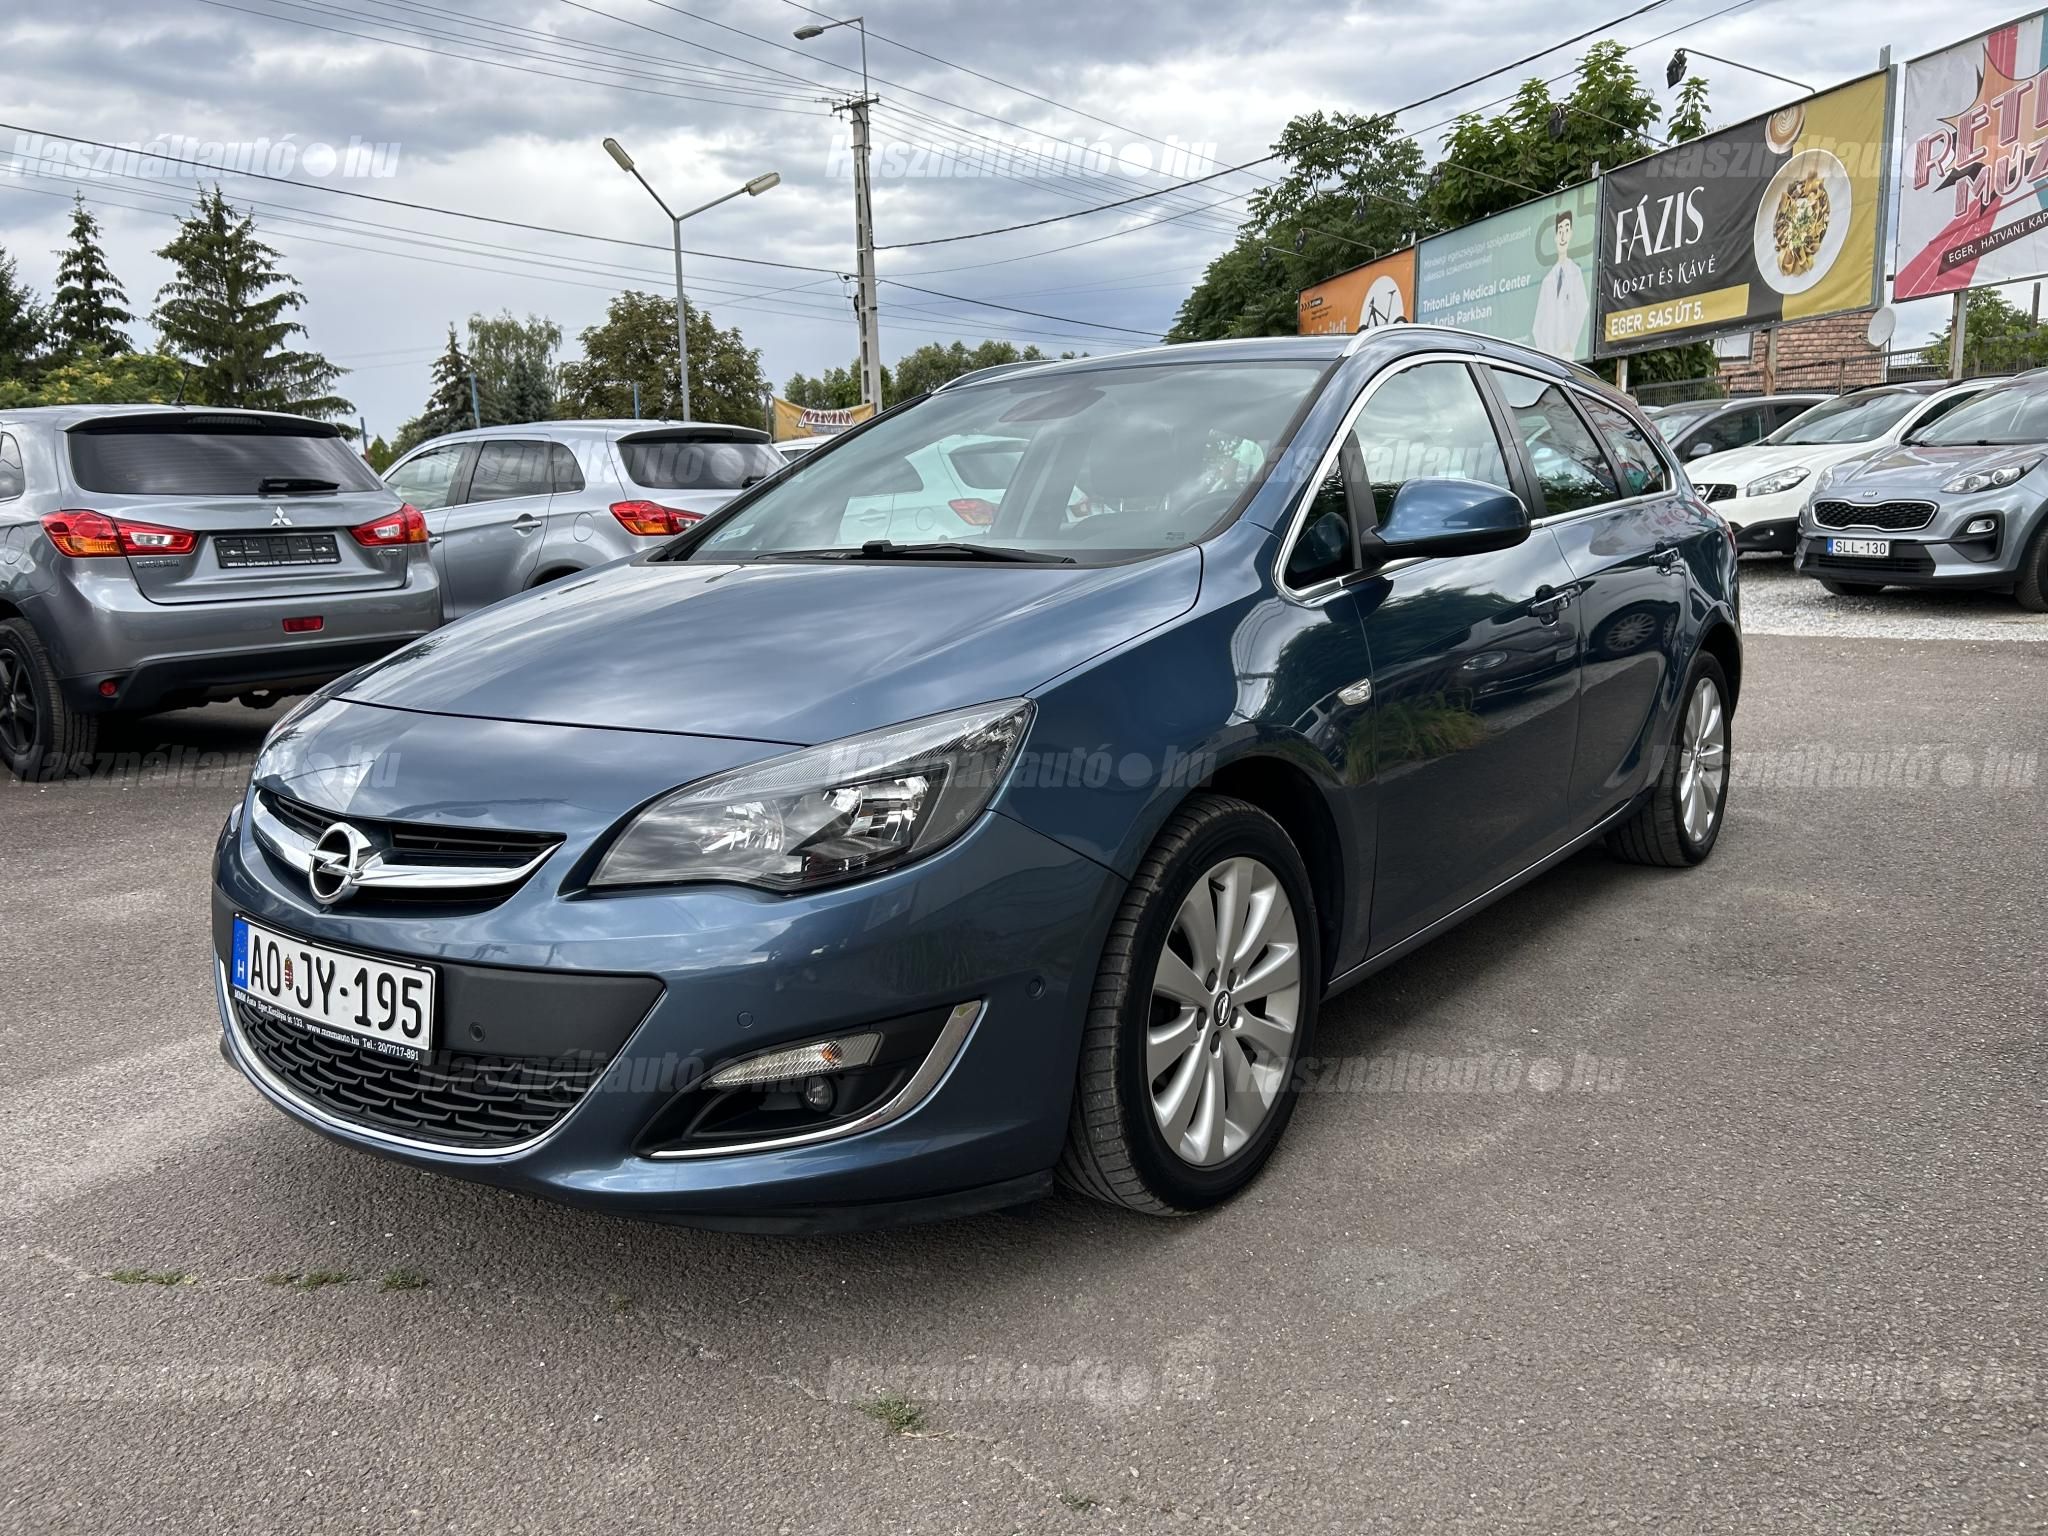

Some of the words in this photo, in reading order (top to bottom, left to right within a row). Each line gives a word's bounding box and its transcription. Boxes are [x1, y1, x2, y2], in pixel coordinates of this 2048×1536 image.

[1614, 186, 1705, 265] FÁZIS
[1948, 244, 1978, 263] EGER,
[1981, 222, 2025, 249] HATVANI
[1613, 273, 1654, 299] KOSZT
[1658, 267, 1673, 286] ÉS
[1678, 254, 1716, 284] KÁVÉ
[1423, 291, 1460, 313] TritonLife
[1462, 280, 1497, 303] Medical
[1499, 274, 1531, 293] Center
[1456, 305, 1492, 325] Parkban
[1647, 306, 1673, 329] SAS
[1675, 300, 1693, 324] ÚT
[1693, 301, 1704, 321] 5.
[1835, 540, 1887, 555] SLL-130
[237, 958, 245, 980] H
[362, 1037, 377, 1050] Tel.:
